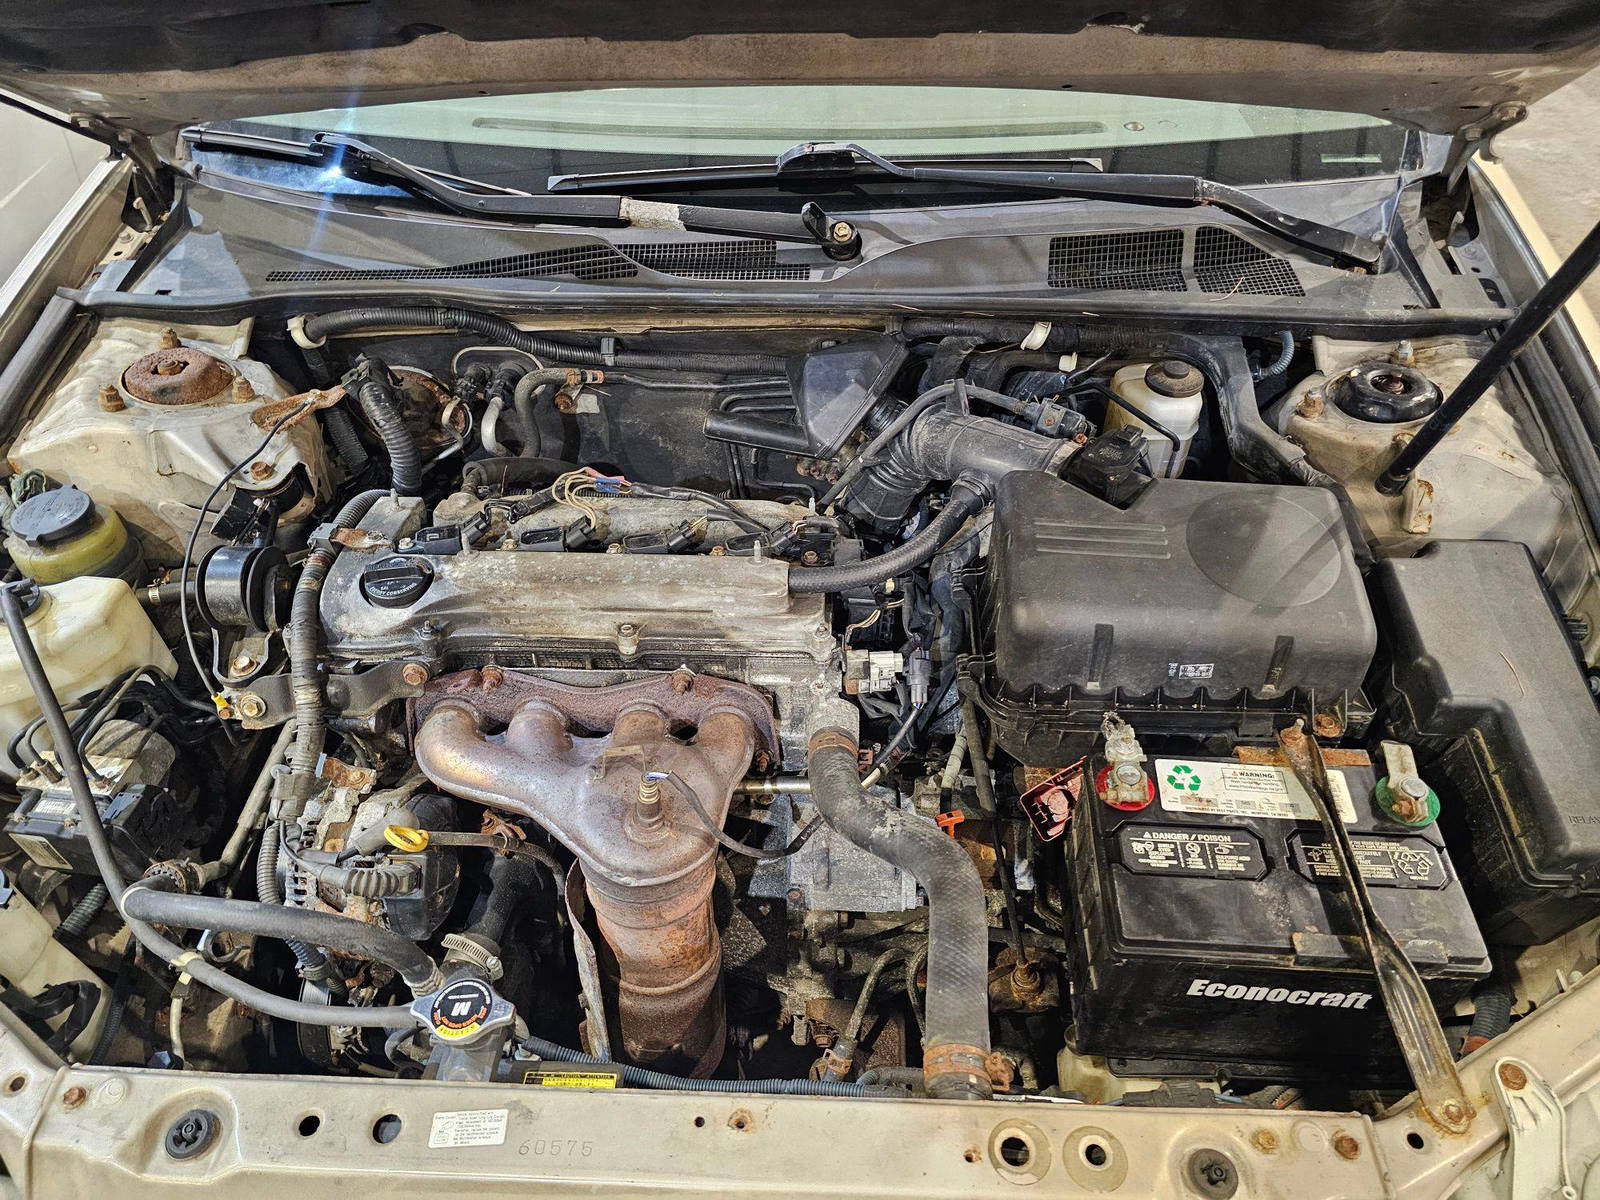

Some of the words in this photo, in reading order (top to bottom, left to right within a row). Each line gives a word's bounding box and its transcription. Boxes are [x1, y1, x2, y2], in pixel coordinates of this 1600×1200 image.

[1152, 832, 1190, 841] DANGER
[1197, 834, 1232, 843] POISON
[1186, 978, 1373, 1010] Econocraft
[518, 1139, 593, 1157] 60575
